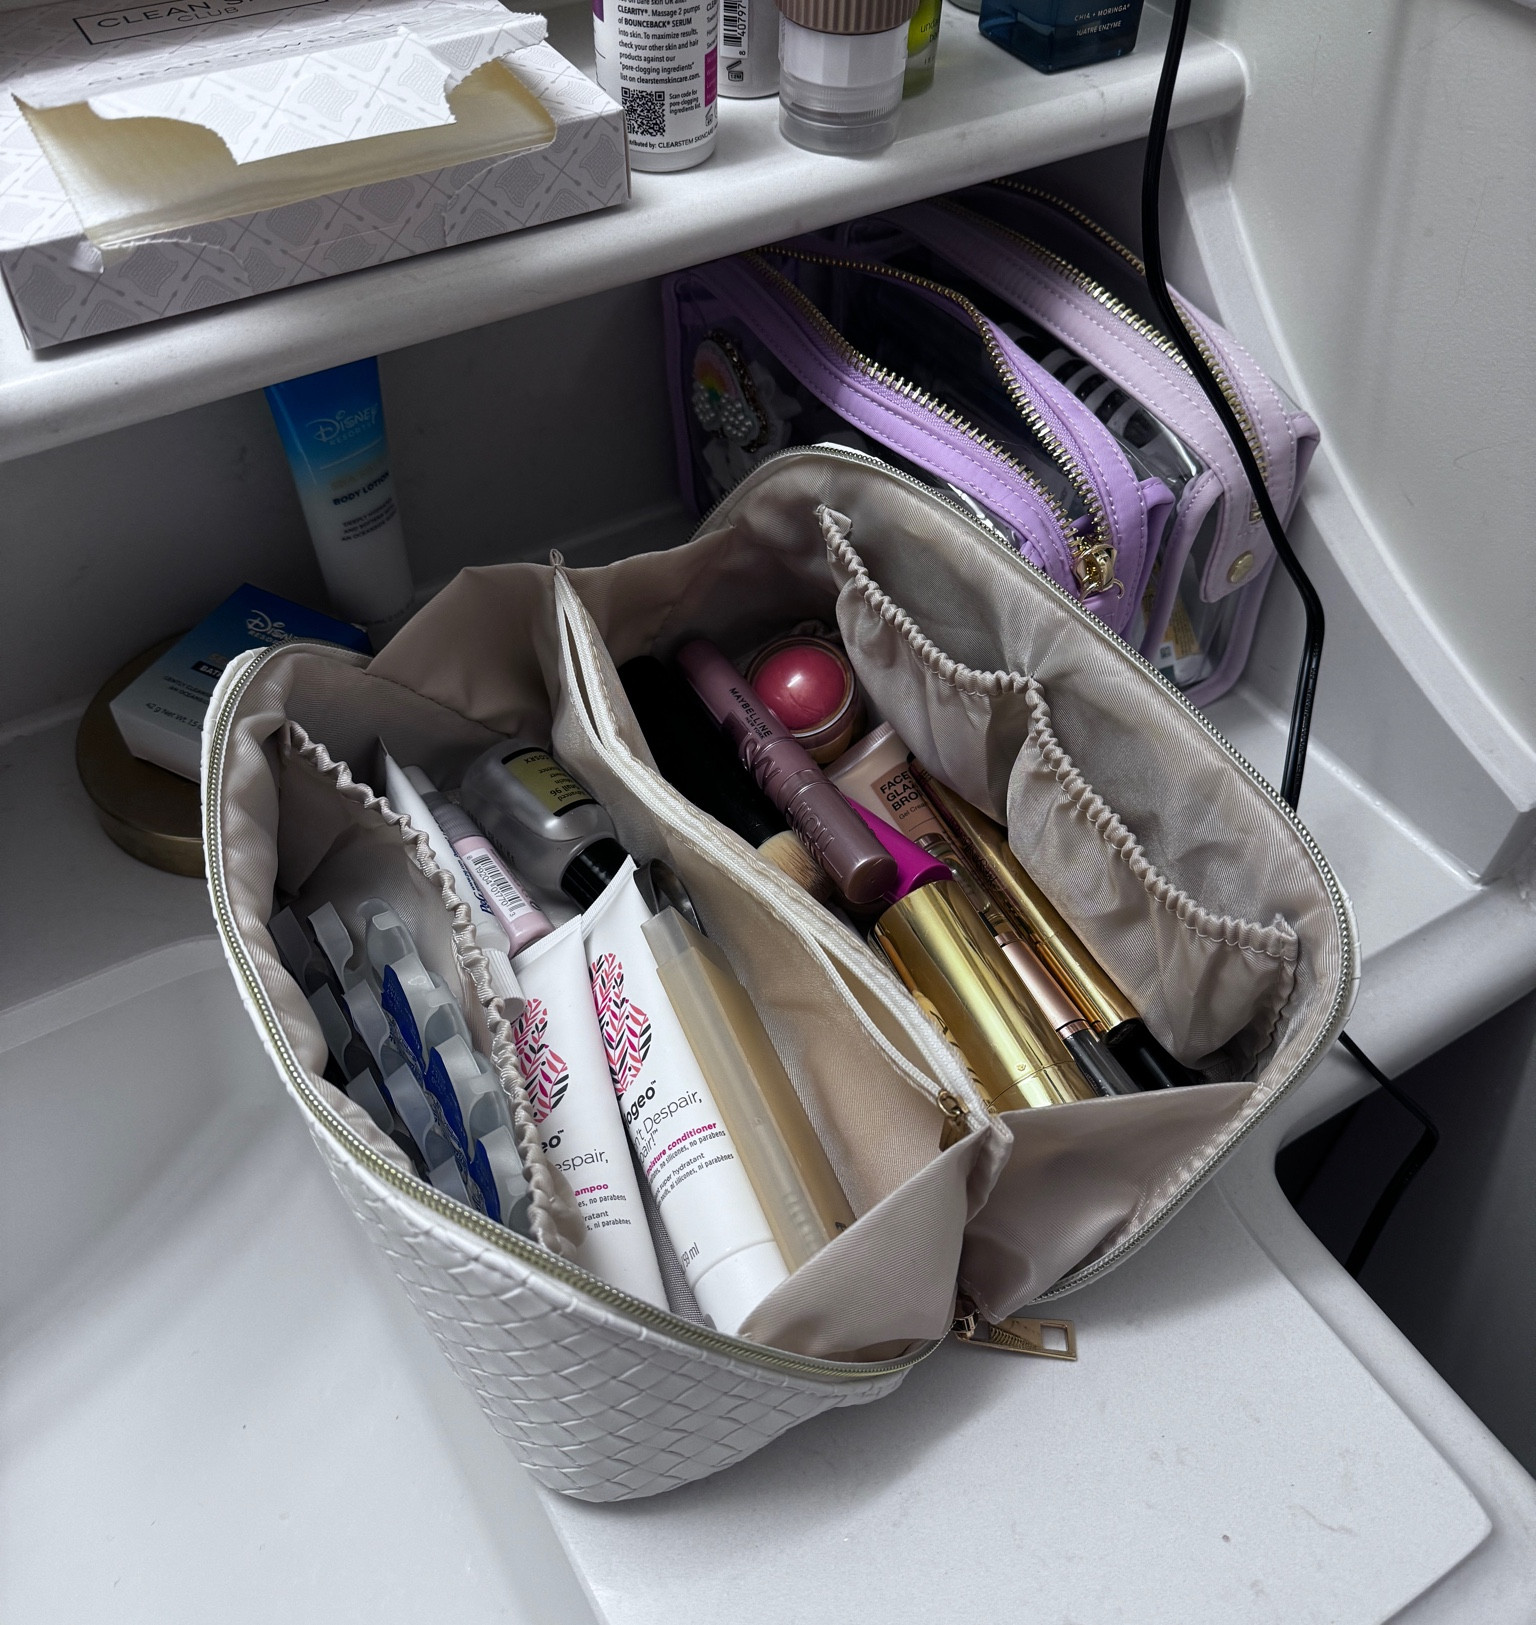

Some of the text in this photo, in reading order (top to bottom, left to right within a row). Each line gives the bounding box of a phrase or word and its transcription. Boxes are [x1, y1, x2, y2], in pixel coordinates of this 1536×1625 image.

[97, 1, 211, 27] CLEAN
[177, 6, 239, 22] CLUB
[651, 9, 677, 18] Massage
[678, 7, 682, 15] 2
[683, 5, 700, 16] pumps
[1074, 12, 1090, 21] CHIA
[672, 17, 692, 28] SERUM
[1098, 20, 1122, 32] ENZYME
[618, 28, 629, 37] into
[630, 31, 643, 39] skin.
[651, 32, 679, 40] maximize
[618, 40, 633, 49] check
[648, 43, 664, 51] other
[678, 41, 688, 49] and
[689, 39, 698, 47] hair
[619, 52, 642, 61] products
[643, 55, 665, 64] against
[620, 72, 628, 81] list
[681, 90, 691, 98] code
[681, 97, 698, 106] clogging
[669, 105, 694, 115] ingredients
[657, 138, 694, 148] CLEARSTEM
[332, 489, 360, 505] BODY
[729, 687, 773, 737] MAYBELLINE
[745, 717, 766, 740] NEW YORK
[880, 771, 909, 794] FACE
[886, 780, 914, 801] GLA
[550, 788, 562, 797] 96
[891, 791, 919, 811] BRO
[899, 802, 926, 819] Gel Crea
[490, 885, 508, 906] 01770
[643, 1091, 702, 1134] Despair,
[667, 1122, 717, 1151] conditioner
[690, 1139, 697, 1148] no
[698, 1130, 726, 1144] parabens
[639, 1128, 658, 1164] pair!™
[555, 1148, 609, 1172] espair,
[660, 1153, 705, 1190] super hydratant
[574, 1183, 609, 1197] ampoo
[589, 1197, 597, 1205] no
[599, 1194, 627, 1203] parabens
[584, 1210, 609, 1222] ratant
[690, 1242, 700, 1261] ml
